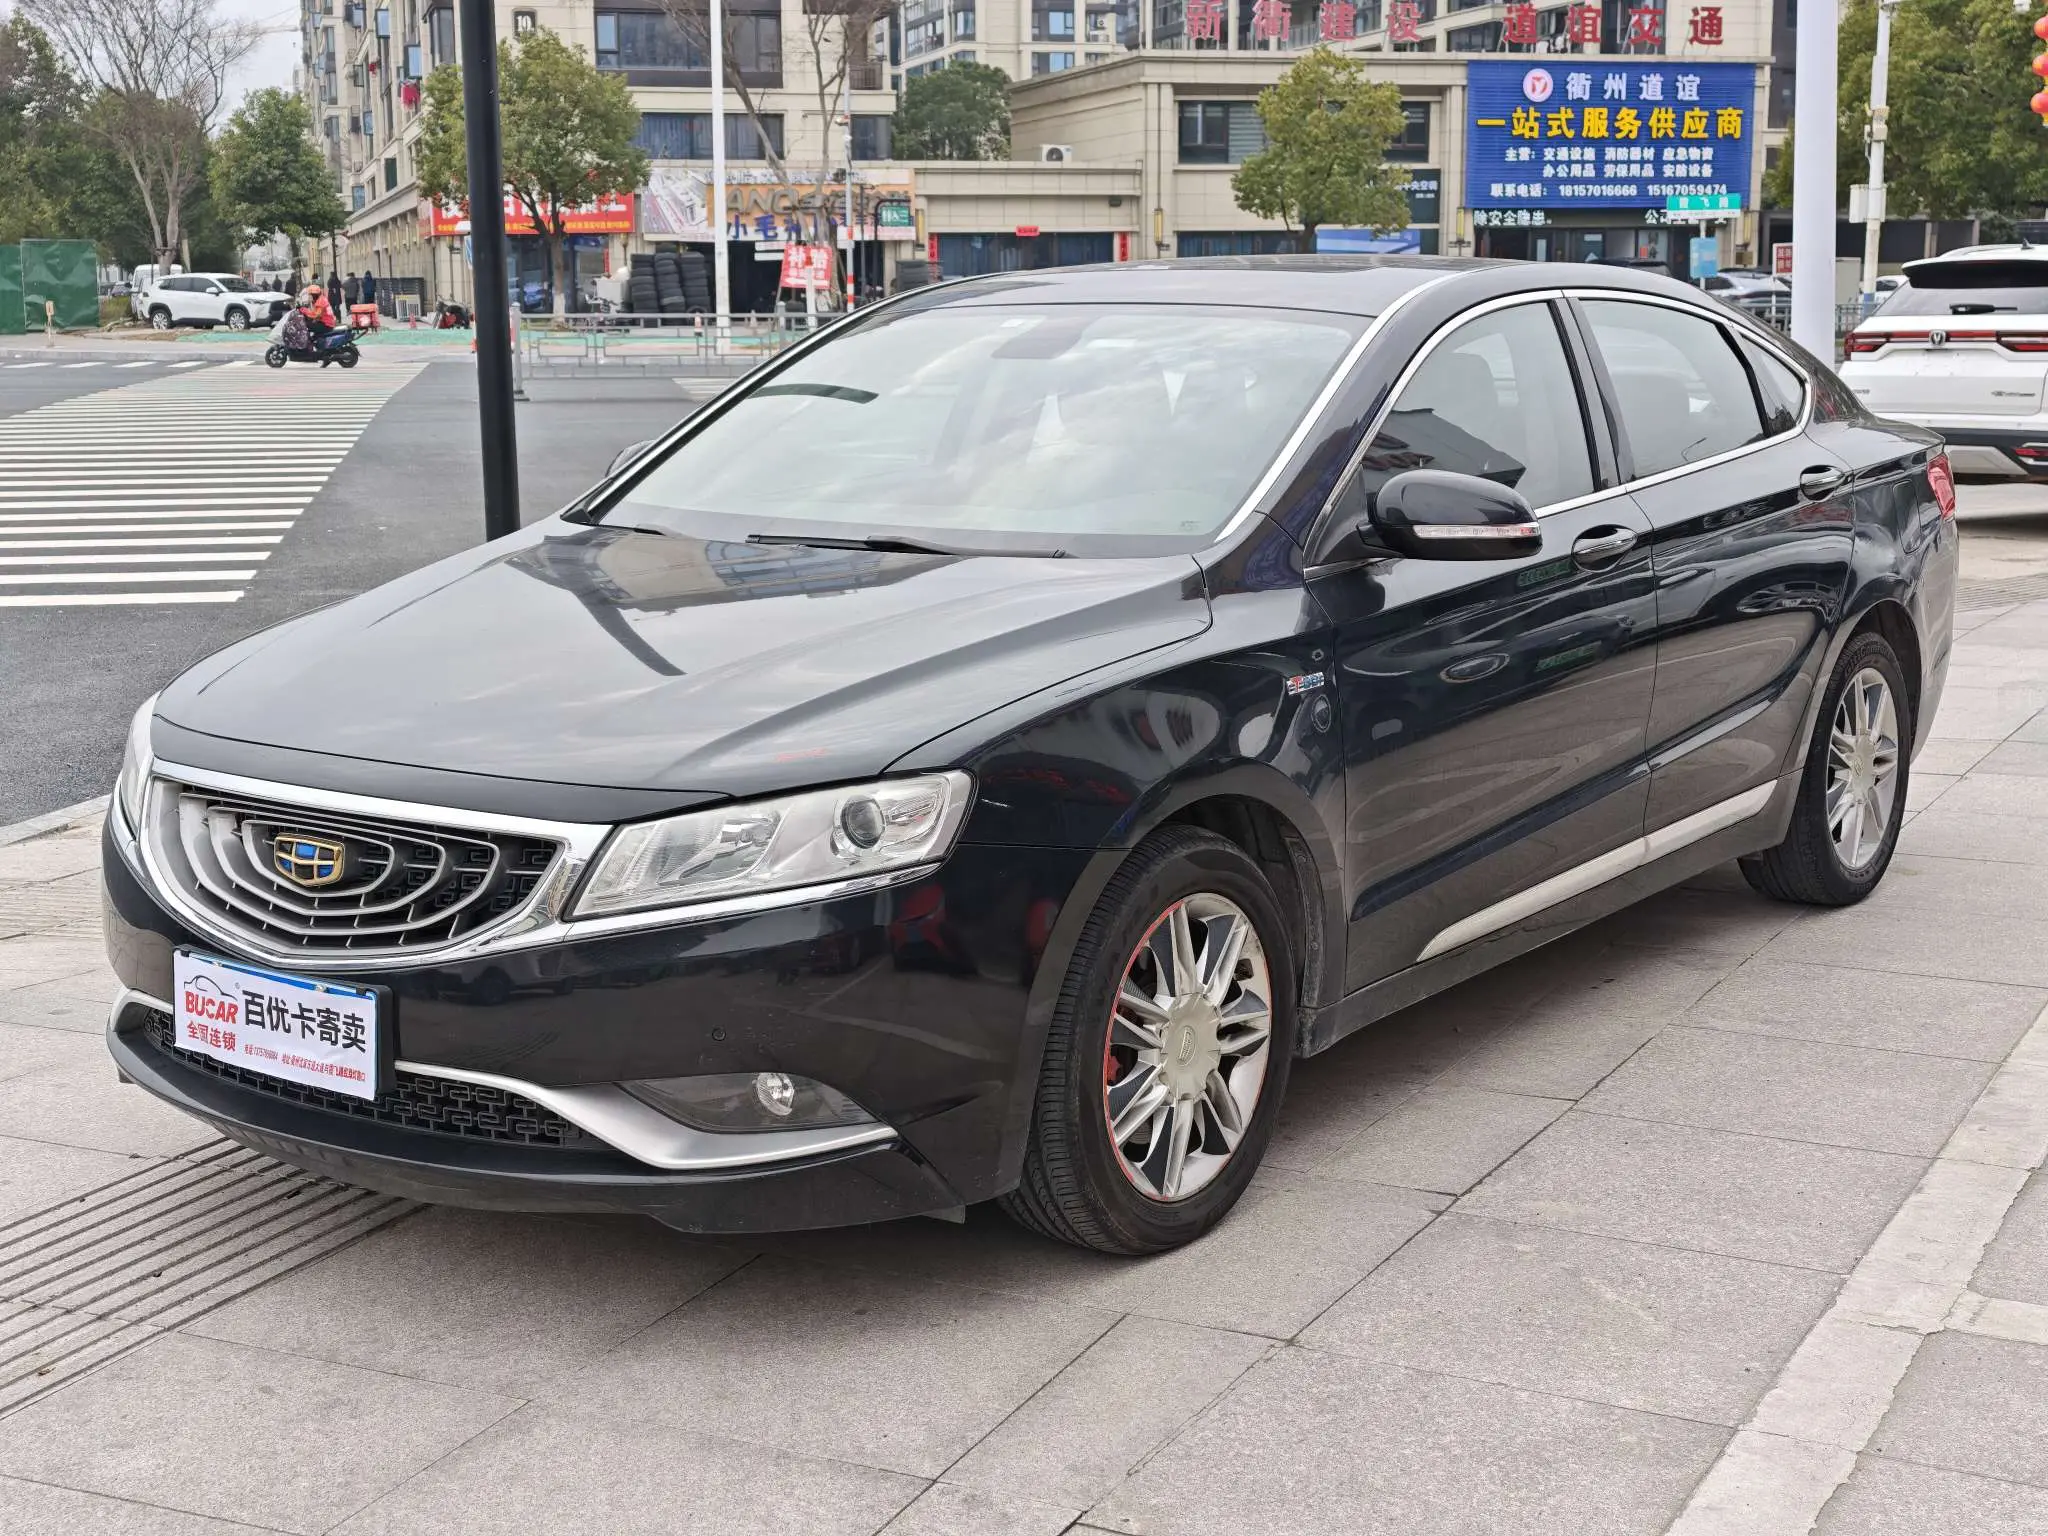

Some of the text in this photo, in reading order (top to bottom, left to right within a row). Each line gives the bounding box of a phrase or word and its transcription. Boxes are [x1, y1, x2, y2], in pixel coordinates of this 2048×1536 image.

[1503, 3, 1723, 45] 道谊交通
[1566, 72, 1701, 101] 衢州道谊
[1476, 106, 1744, 139] 一站式服务供应商
[1543, 147, 1596, 161] 交通设施
[1604, 147, 1655, 161] 消防器材
[1543, 163, 1596, 177] 办公用品
[1603, 163, 1655, 177] 劳保用品
[185, 991, 239, 1025] BUCAR
[242, 989, 366, 1054] 百优卡寄卖
[187, 1020, 237, 1052] 全国连锁
